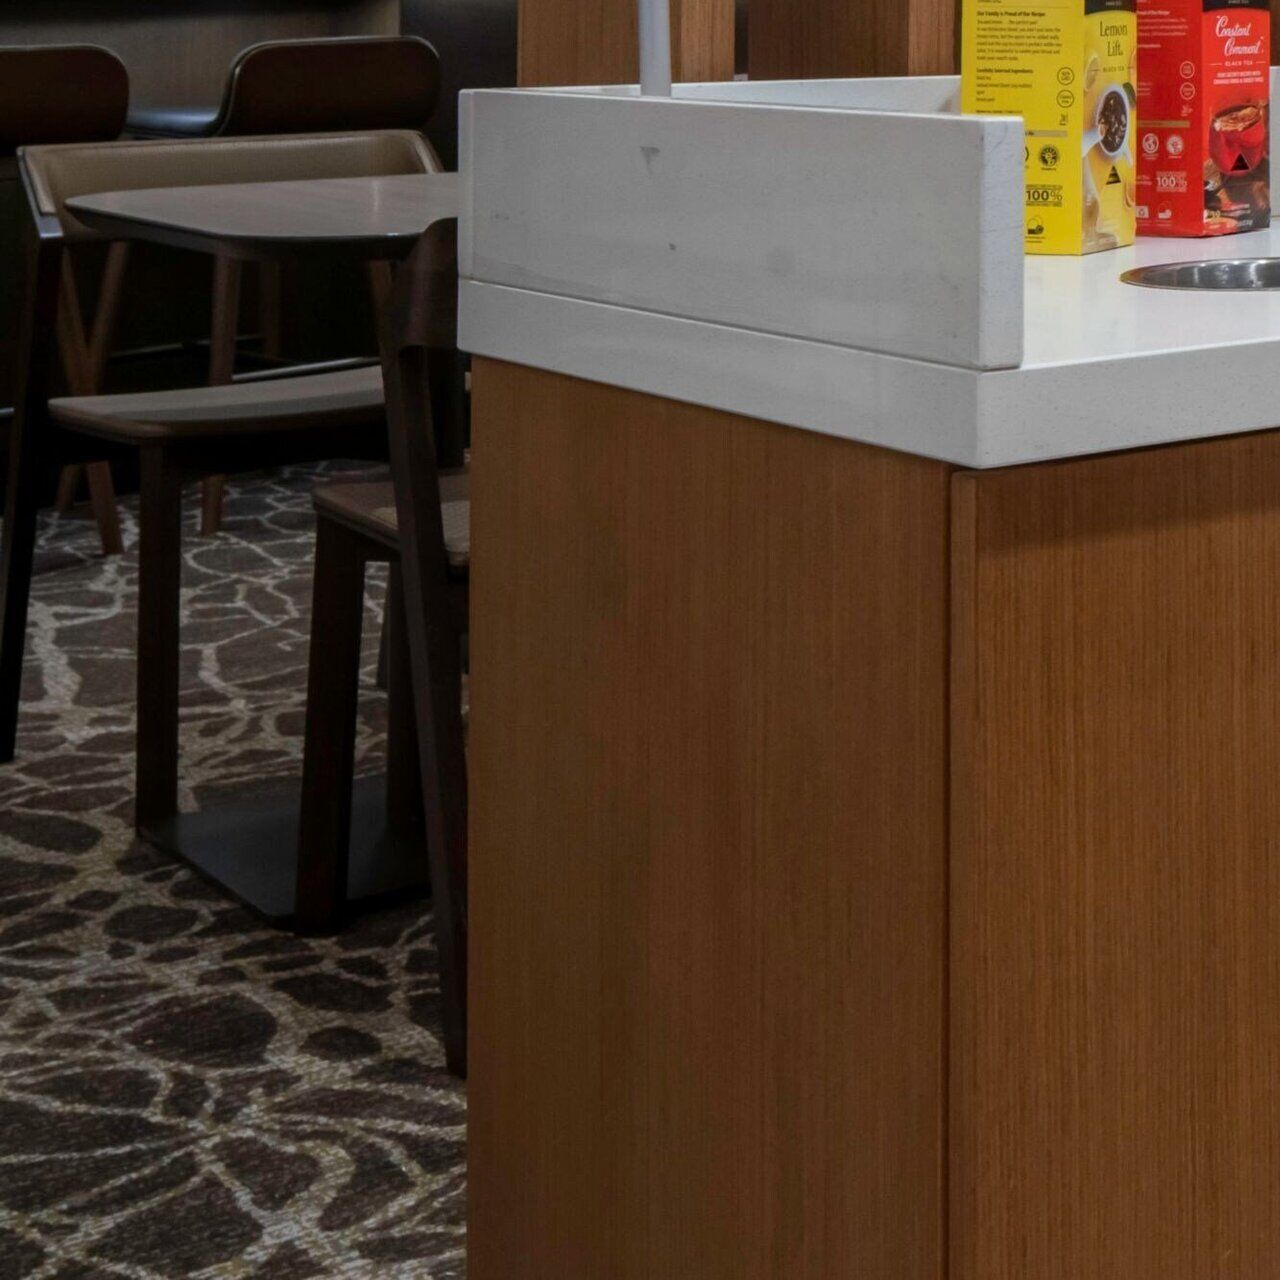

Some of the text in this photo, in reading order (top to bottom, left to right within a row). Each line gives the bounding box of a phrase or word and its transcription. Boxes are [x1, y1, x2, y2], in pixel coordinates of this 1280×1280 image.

[1100, 21, 1127, 37] Lemon
[1156, 177, 1187, 188] 100%
[1027, 190, 1063, 201] 100%
